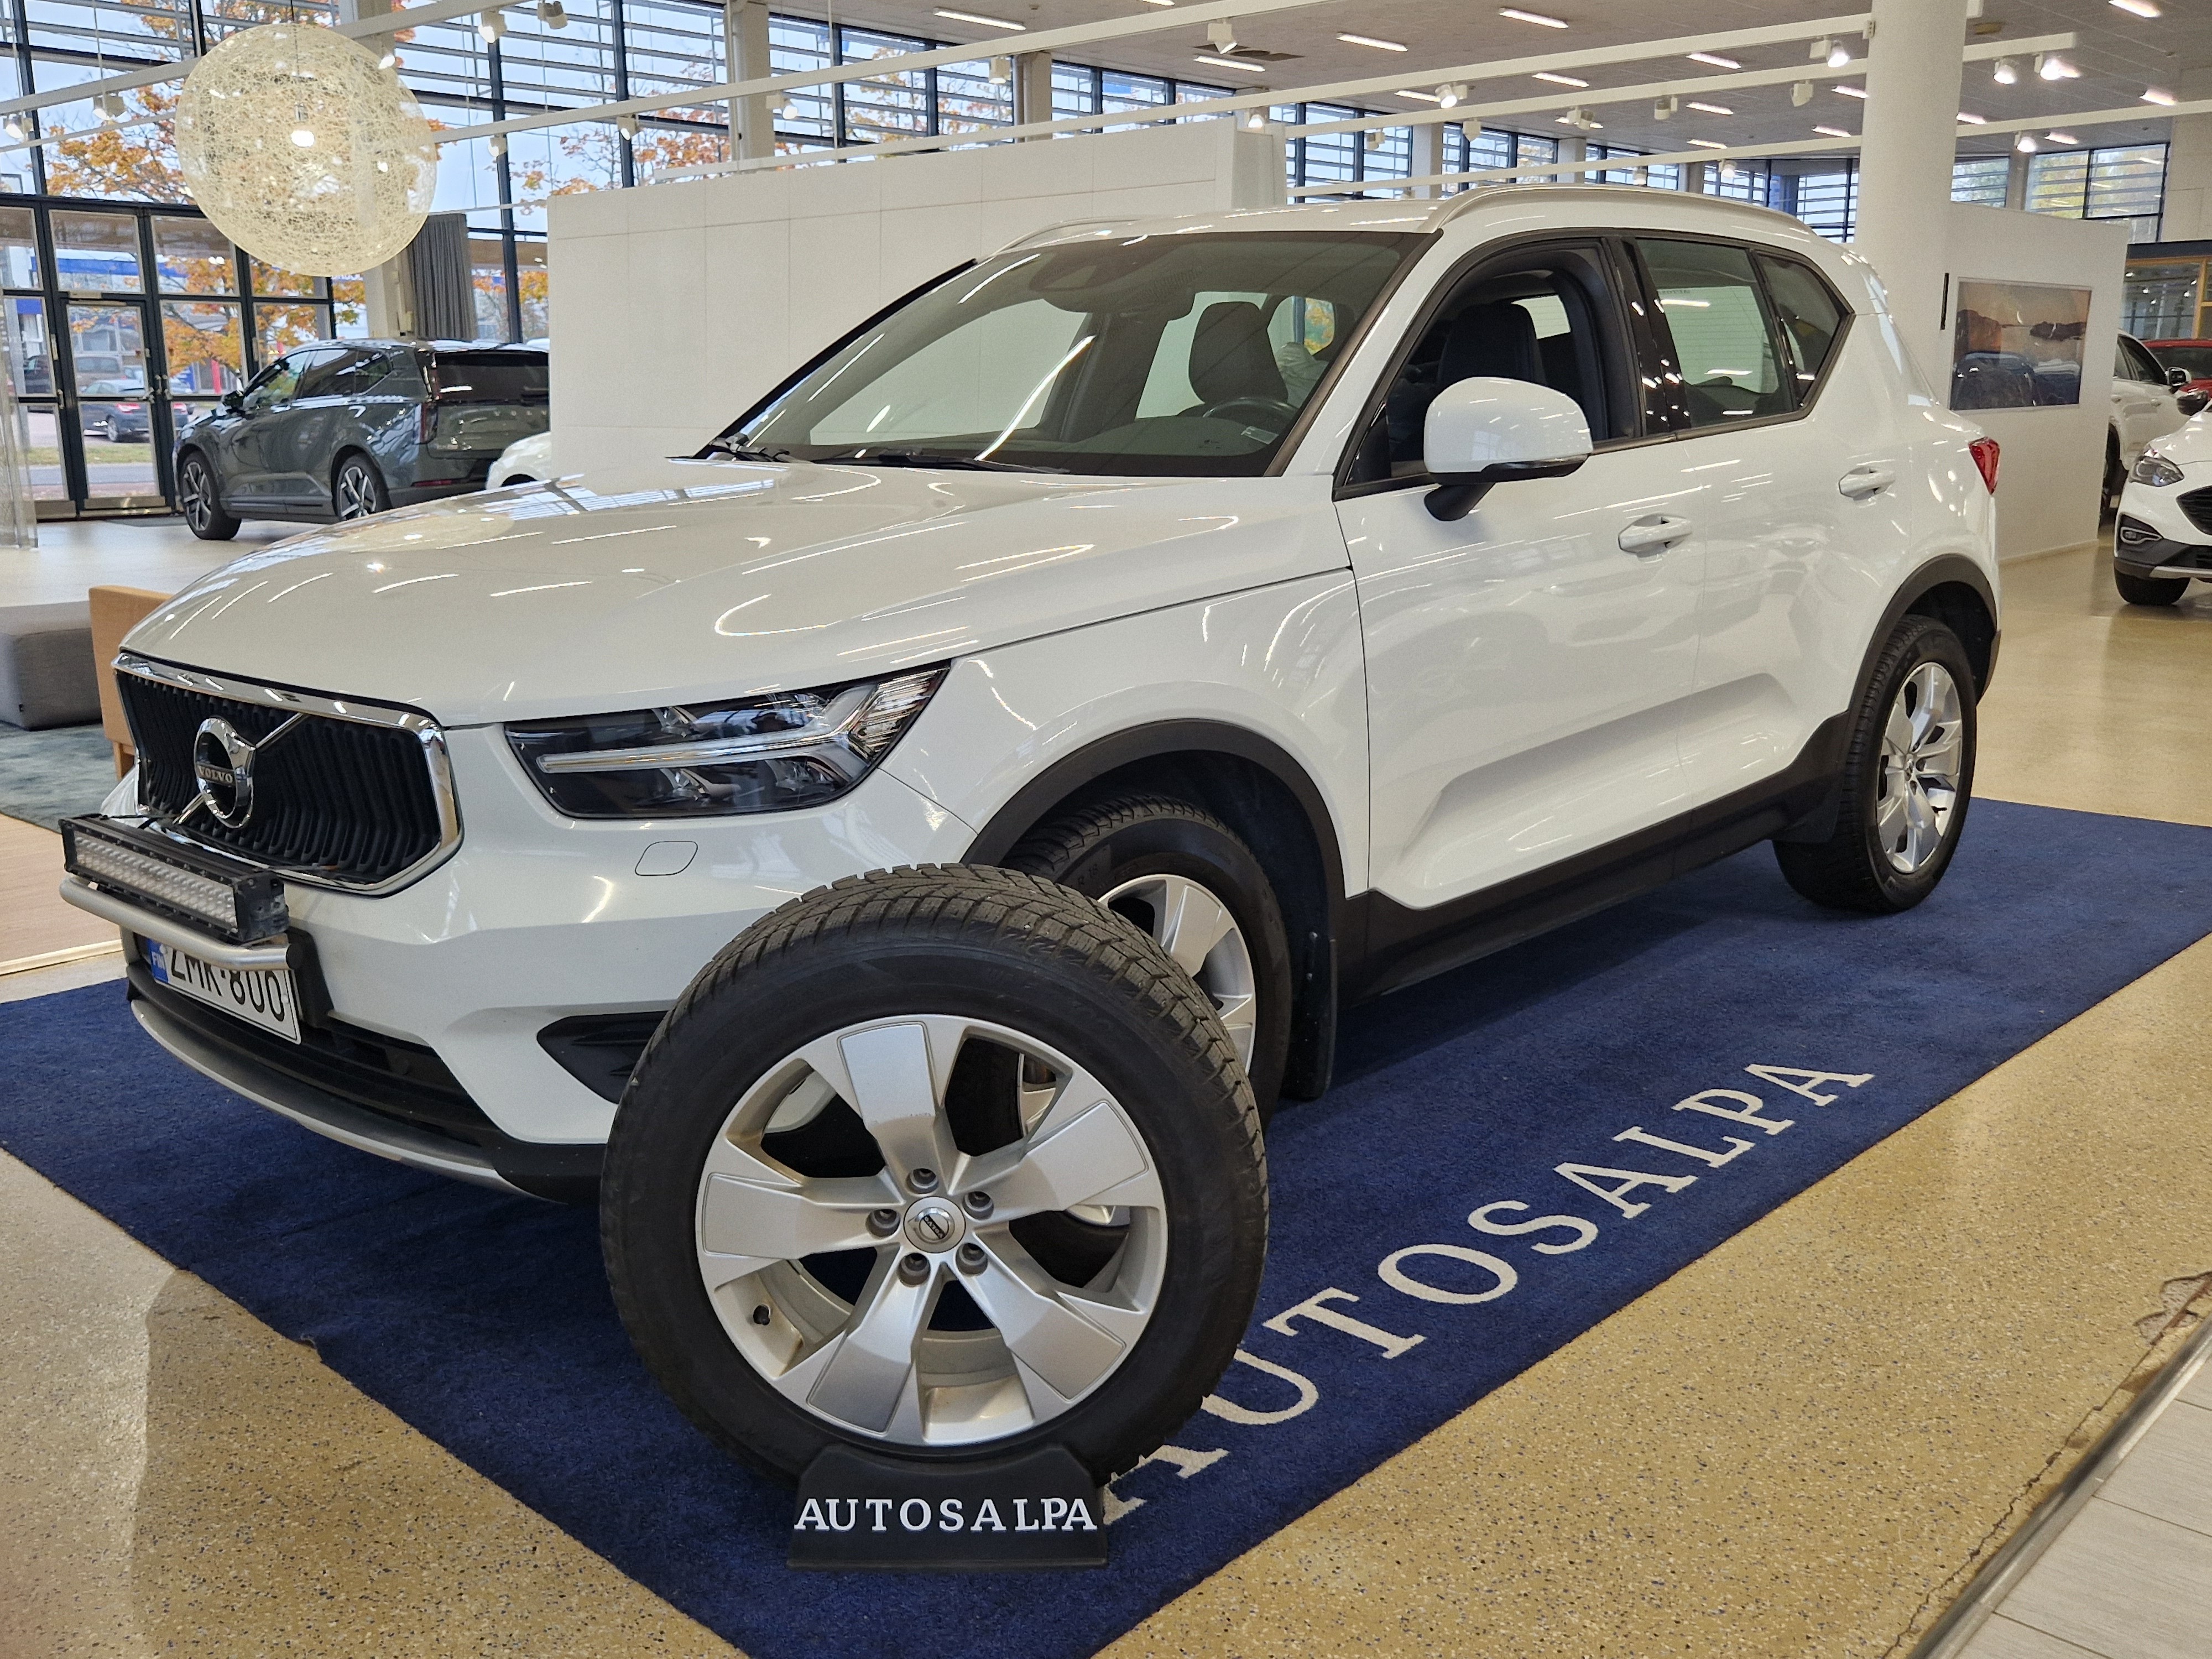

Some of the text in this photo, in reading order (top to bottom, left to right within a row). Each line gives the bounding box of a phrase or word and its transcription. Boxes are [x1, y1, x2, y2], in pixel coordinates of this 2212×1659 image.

[197, 765, 233, 783] VOLVO
[152, 951, 166, 971] FIN
[794, 1498, 1097, 1531] AUTOSALPA
